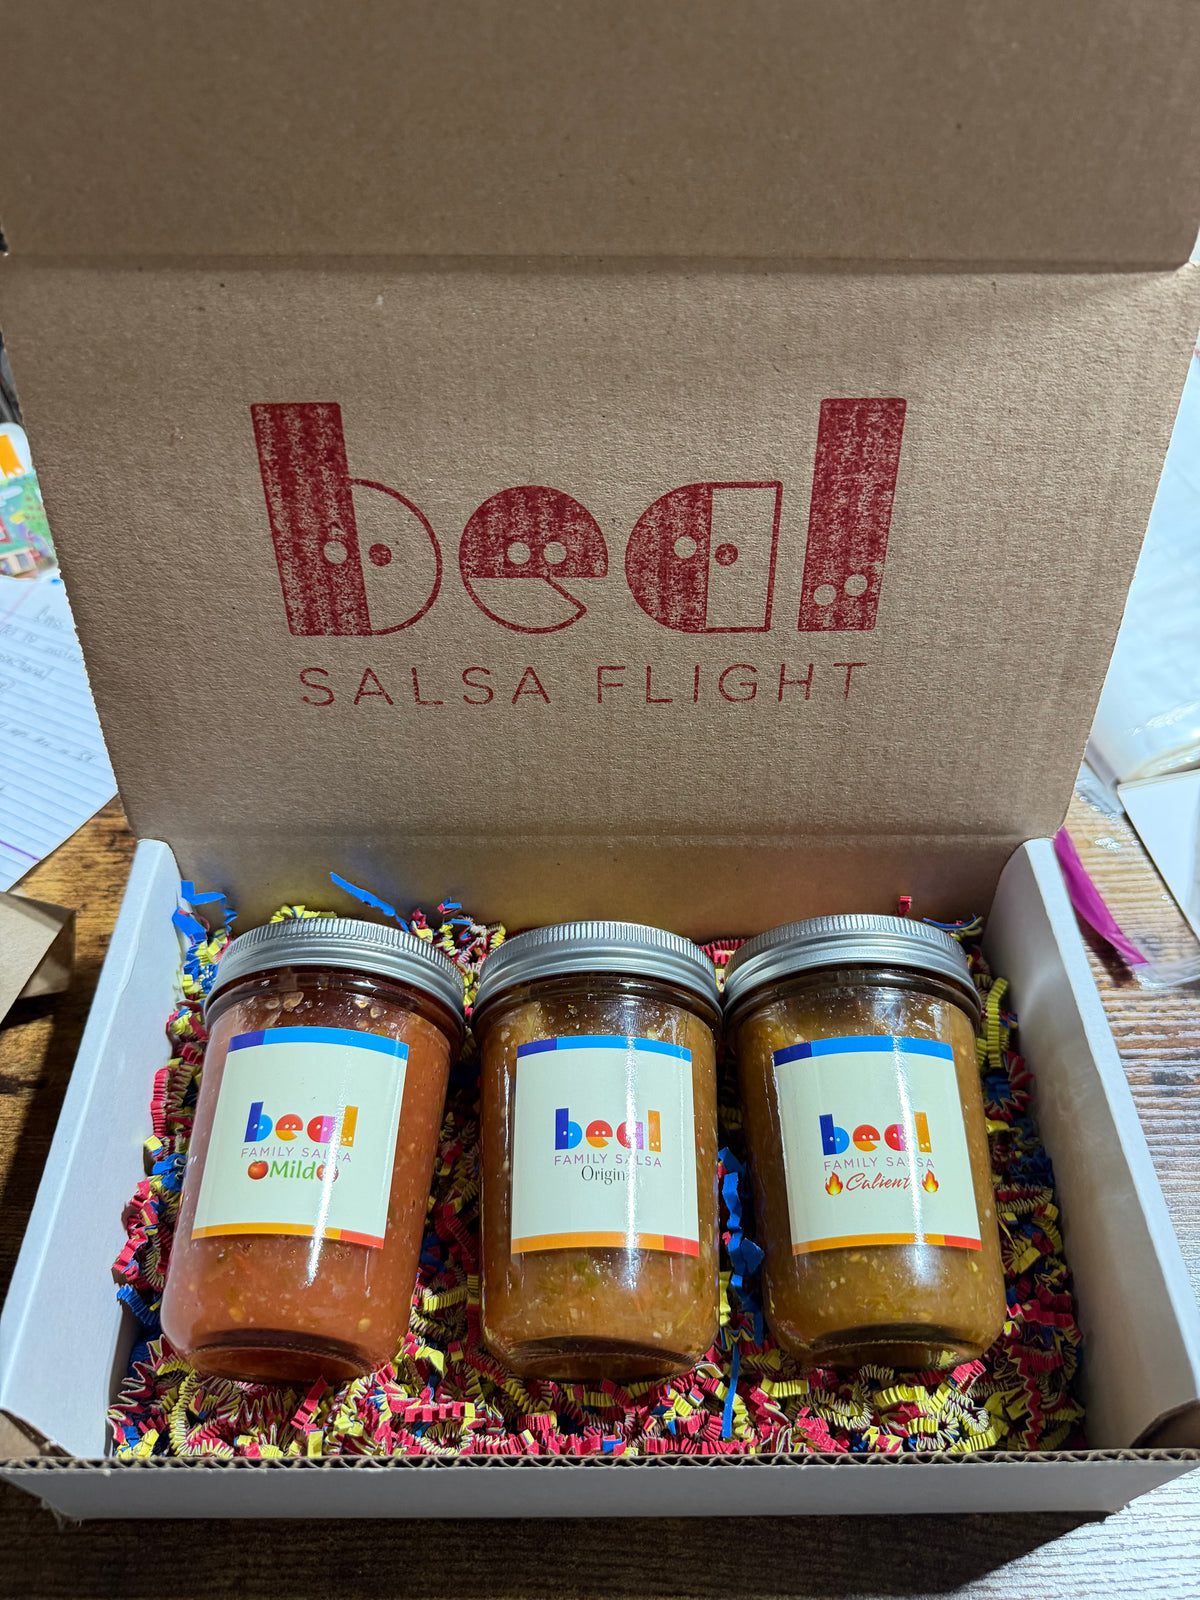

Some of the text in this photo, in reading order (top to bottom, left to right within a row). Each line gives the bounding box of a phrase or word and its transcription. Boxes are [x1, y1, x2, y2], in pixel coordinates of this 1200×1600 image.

[299, 662, 867, 706] SALSA FLIGHT
[240, 1147, 295, 1159] FAMILY
[554, 1153, 608, 1166] FAMILY
[269, 1160, 317, 1180] Mild
[823, 1156, 935, 1171] FAMILY SASA
[581, 1165, 638, 1186] Origin
[846, 1172, 916, 1192] Calient
